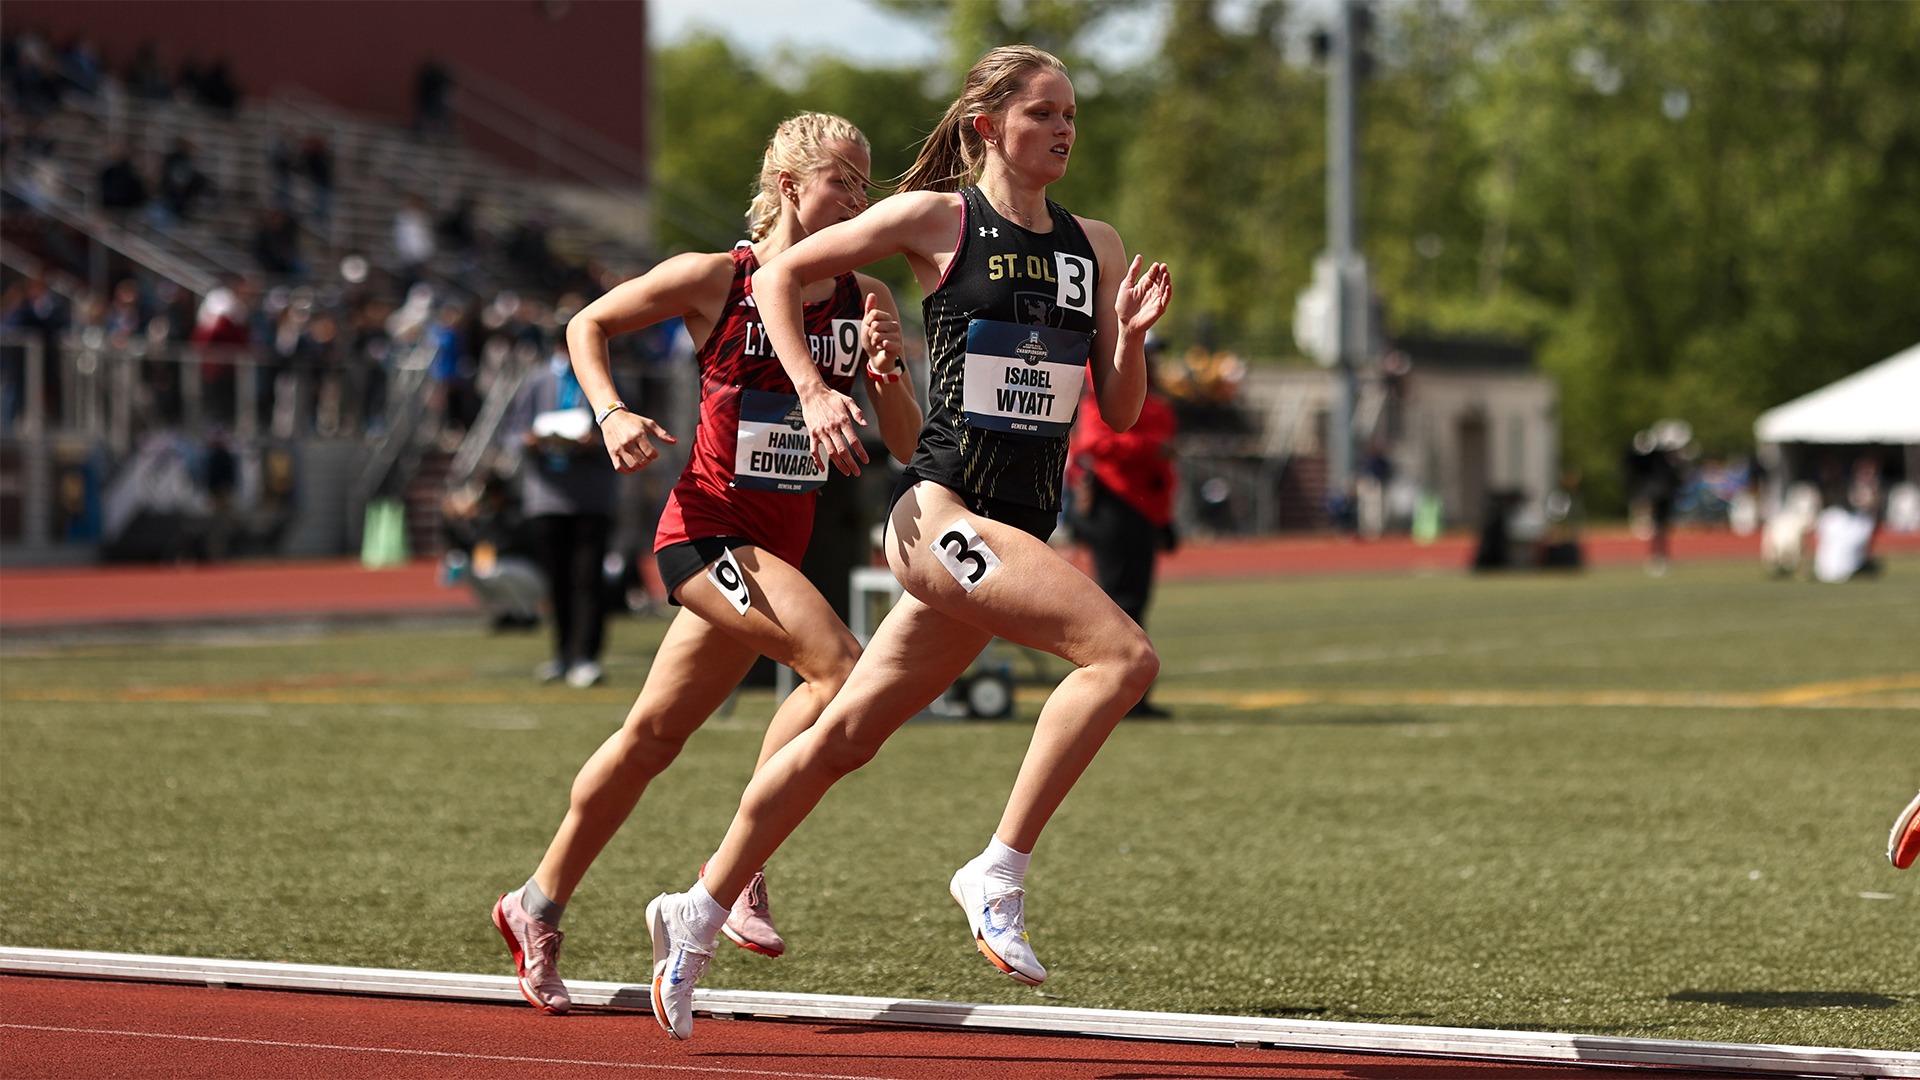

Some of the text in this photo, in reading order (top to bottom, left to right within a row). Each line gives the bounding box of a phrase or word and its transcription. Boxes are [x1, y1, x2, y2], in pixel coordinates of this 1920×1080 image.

[988, 253, 1057, 283] ST. OL
[1064, 257, 1086, 308] 3
[839, 322, 858, 373] 9
[1004, 366, 1052, 389] ISABEL
[996, 388, 1055, 416] WYATT
[750, 451, 819, 477] EDWARDS
[939, 530, 988, 584] 3
[716, 559, 748, 606] 9
